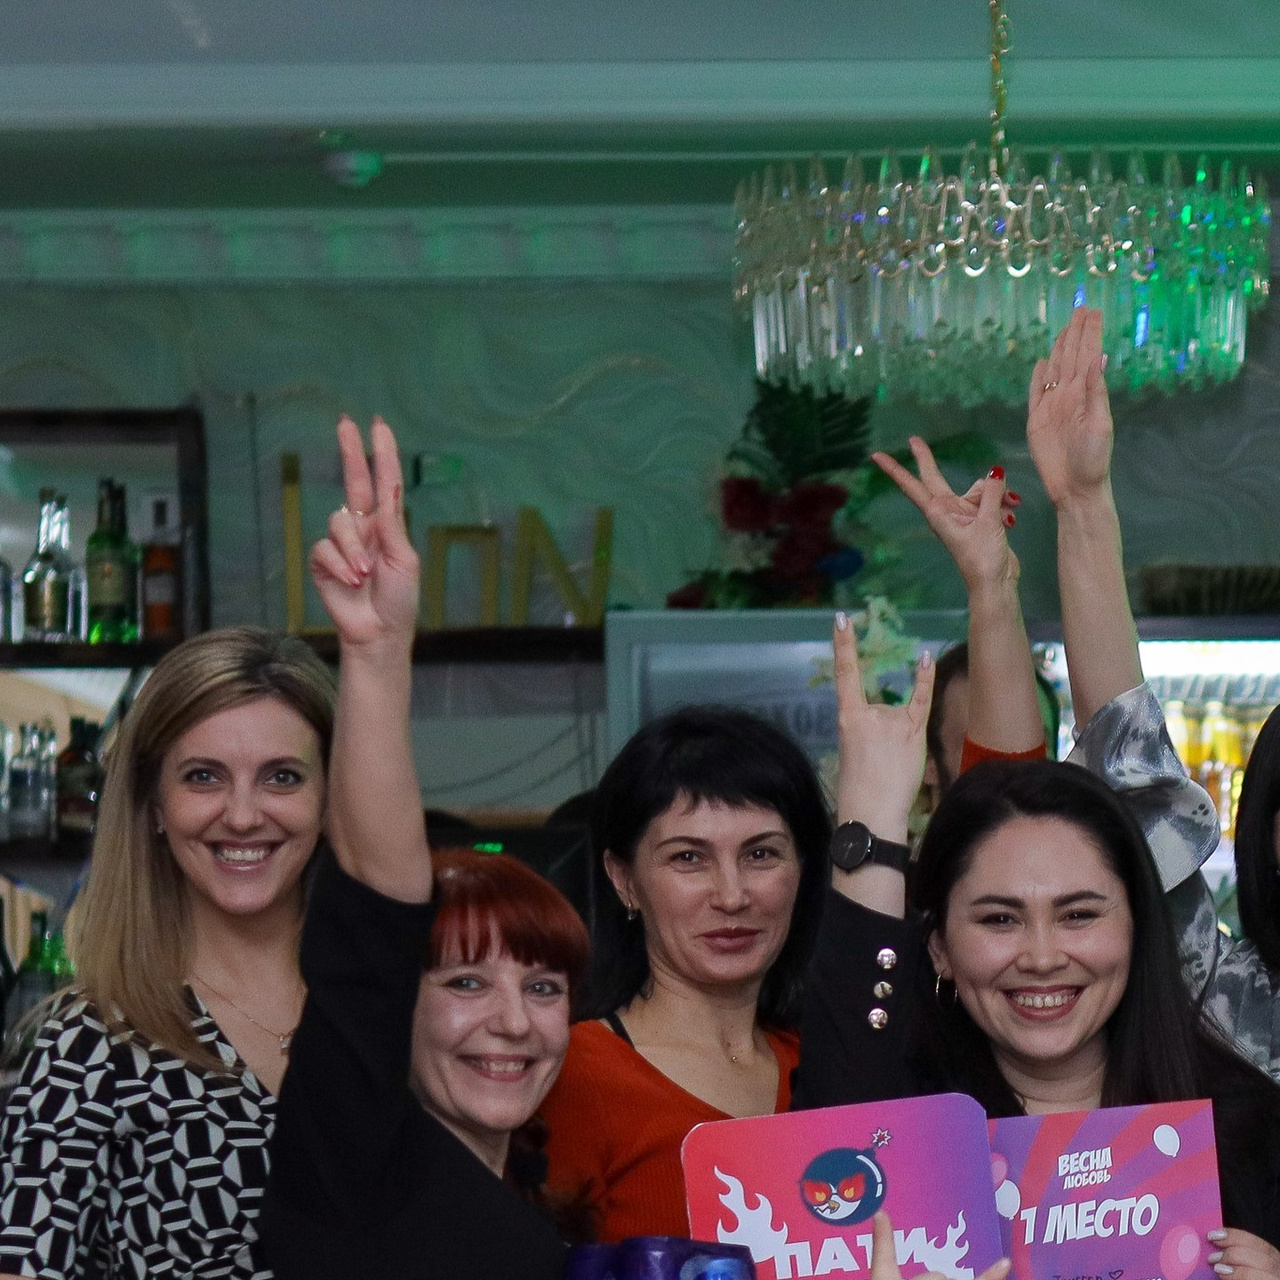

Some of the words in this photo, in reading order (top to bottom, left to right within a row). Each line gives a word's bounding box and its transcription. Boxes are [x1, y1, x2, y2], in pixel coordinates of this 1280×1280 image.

[1058, 1147, 1113, 1177] ВЕСНА
[1063, 1169, 1112, 1191] ЛЮБОВЬ
[1020, 1206, 1037, 1245] 1
[1043, 1193, 1159, 1245] МЕСТО
